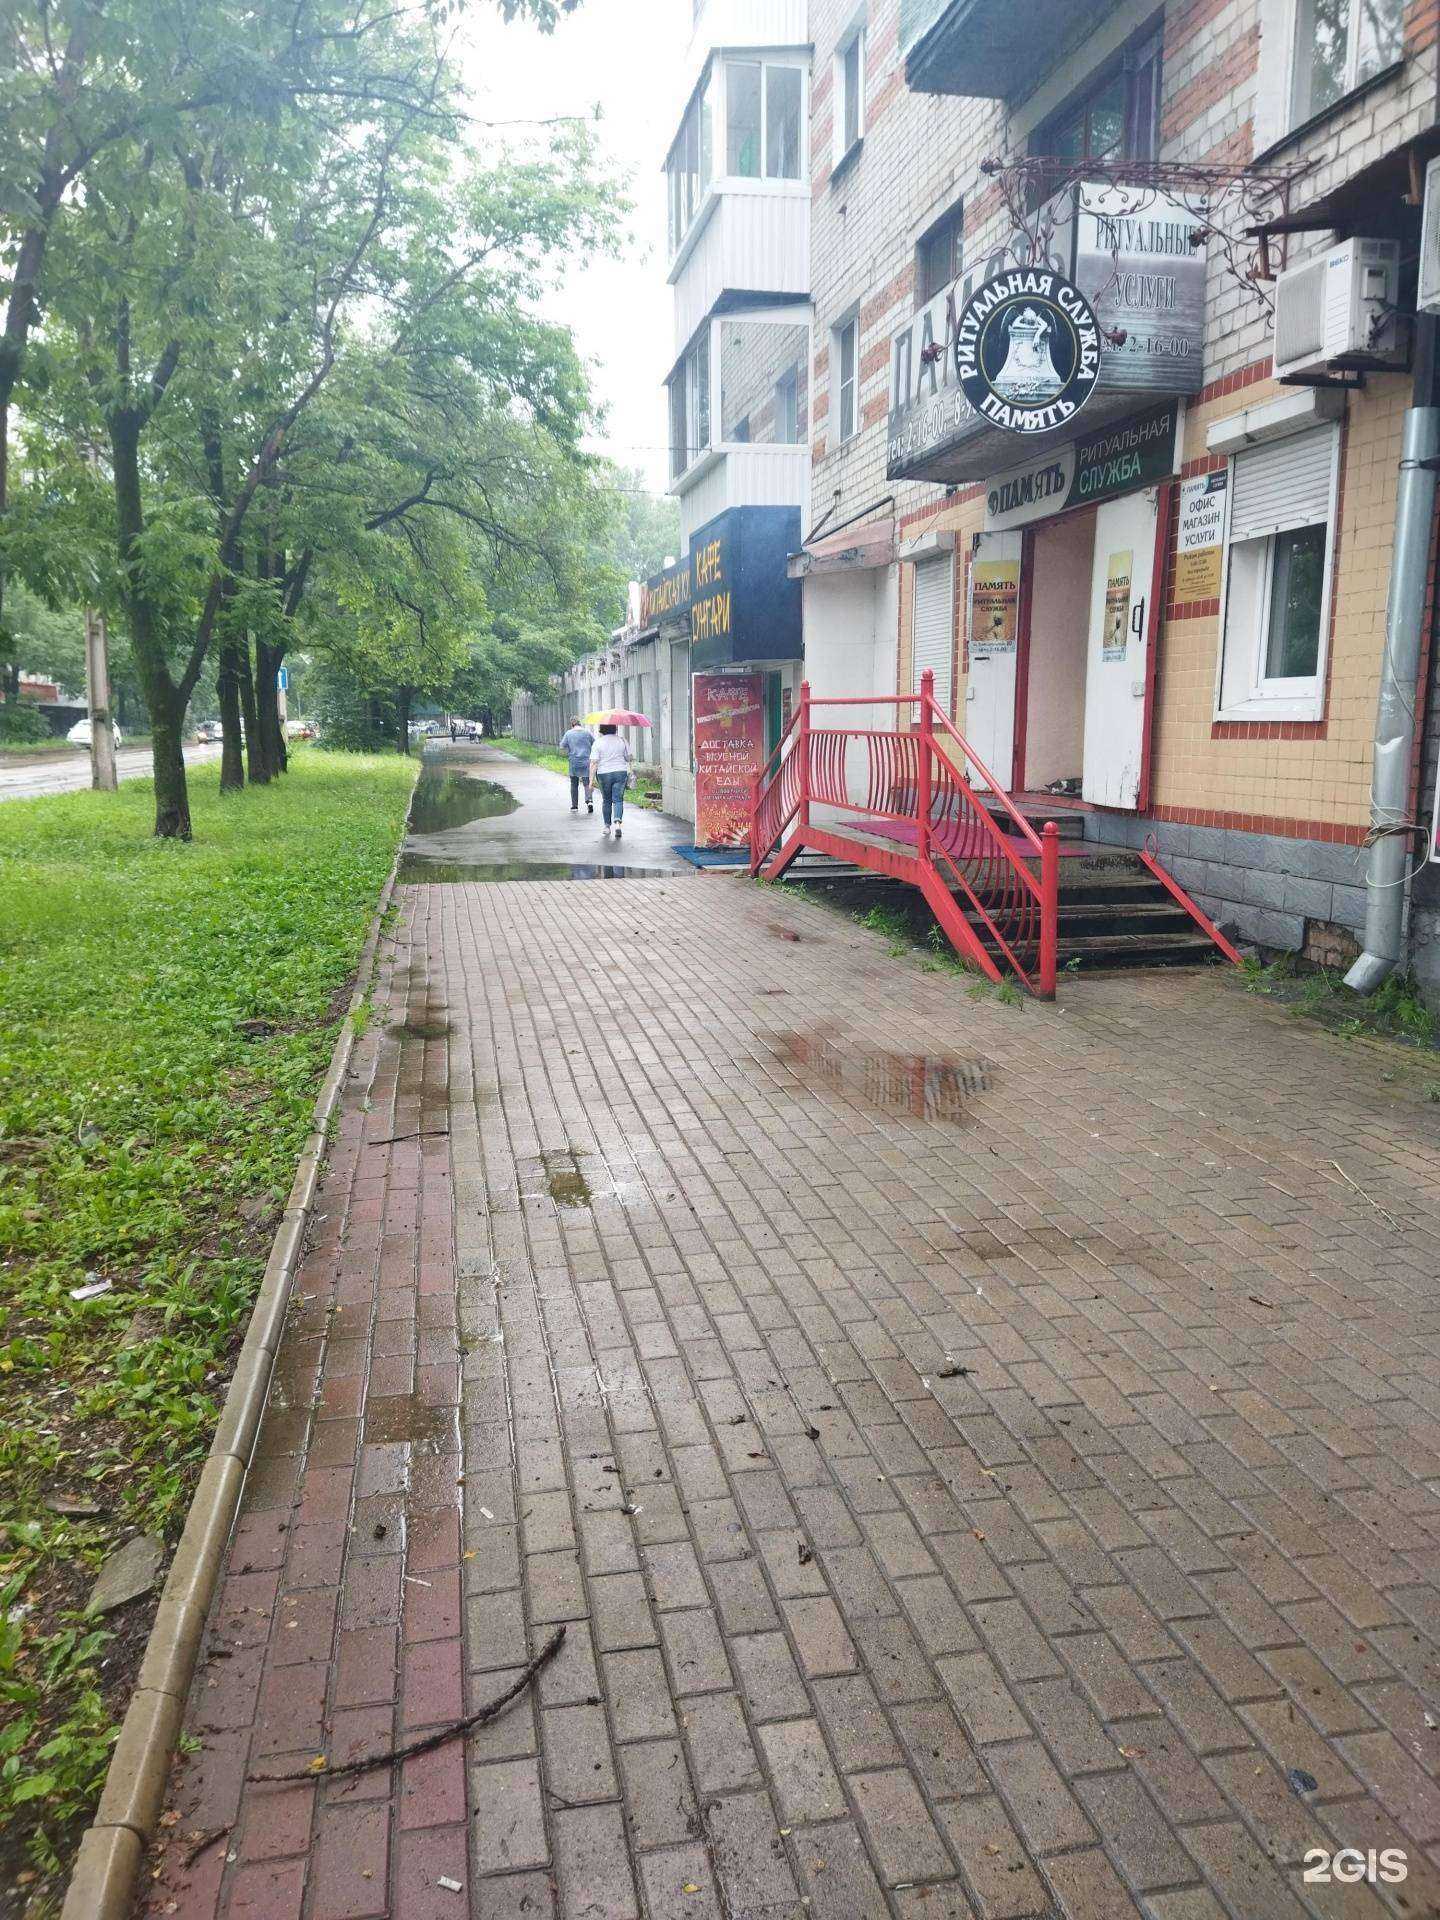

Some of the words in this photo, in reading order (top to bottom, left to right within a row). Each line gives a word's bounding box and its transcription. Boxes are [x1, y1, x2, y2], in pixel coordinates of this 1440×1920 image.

[1095, 217, 1197, 256] РИТУАЛЬНЫЕ
[1114, 272, 1177, 309] УСЛУГИ
[958, 272, 1053, 380] РИТУАЛЬНАЯ
[1057, 287, 1098, 381] СЛУЖБА
[1128, 336, 1191, 357] 2-16-00
[980, 394, 1076, 430] ПАМЯТЬ
[1080, 414, 1170, 465] РИТУАЛЬНАЯ
[1079, 452, 1141, 494] СЛУЖБА
[998, 462, 1066, 514] ПАМЯТЬ
[1190, 495, 1216, 513] ОФИС
[1182, 510, 1221, 531] МАГАЗИН
[1185, 529, 1216, 546] УСЛУГИ
[696, 540, 721, 590] КАФЕ
[974, 581, 1016, 591] ПАМЯТЬ
[700, 739, 754, 749] ДОСТАВКА
[706, 751, 749, 761] ВКУСНОЙ
[699, 763, 758, 774] КИТАЙСКОЙ
[716, 776, 740, 786] ЕДЫ
